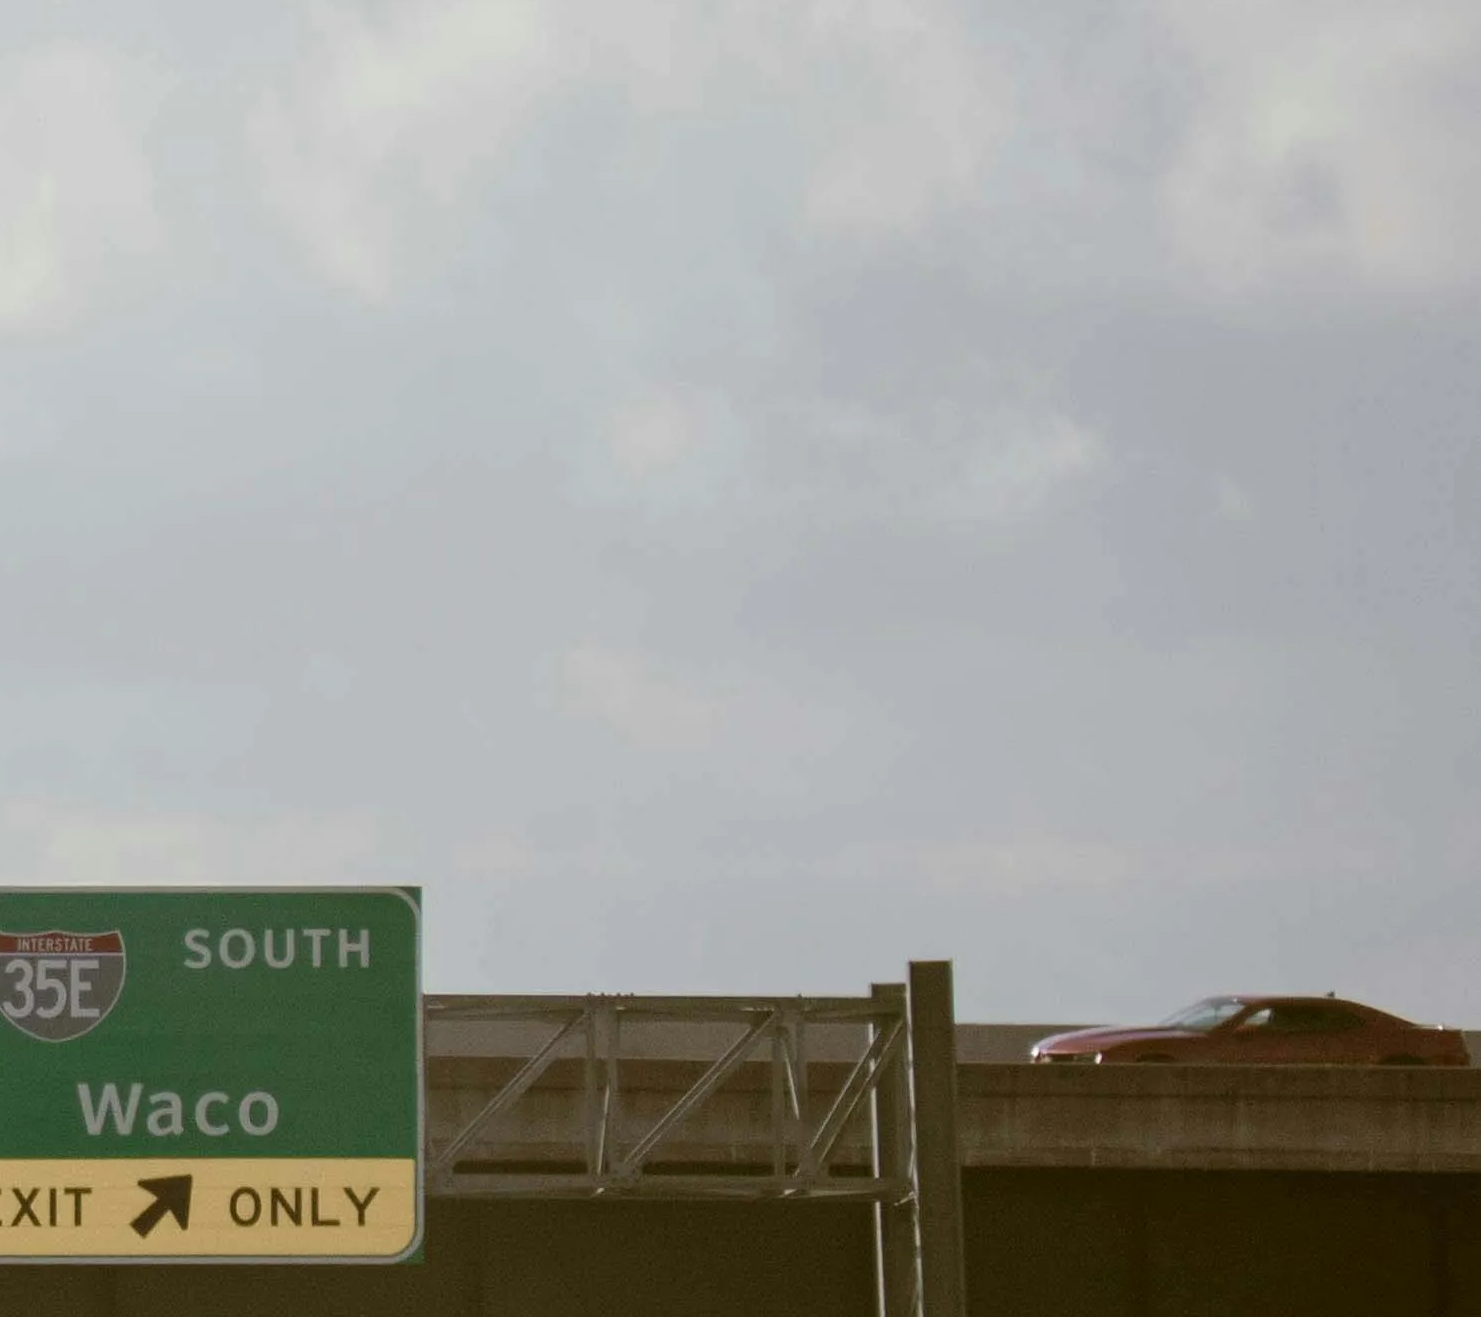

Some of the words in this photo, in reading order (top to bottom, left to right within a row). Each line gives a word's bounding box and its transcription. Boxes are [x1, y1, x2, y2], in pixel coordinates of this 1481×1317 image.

[16, 936, 94, 953] INTERSTATE
[183, 927, 371, 970] SOUTH
[1, 958, 101, 1020] 35E
[77, 1082, 280, 1137] Waco
[228, 1185, 381, 1228] ONLY
